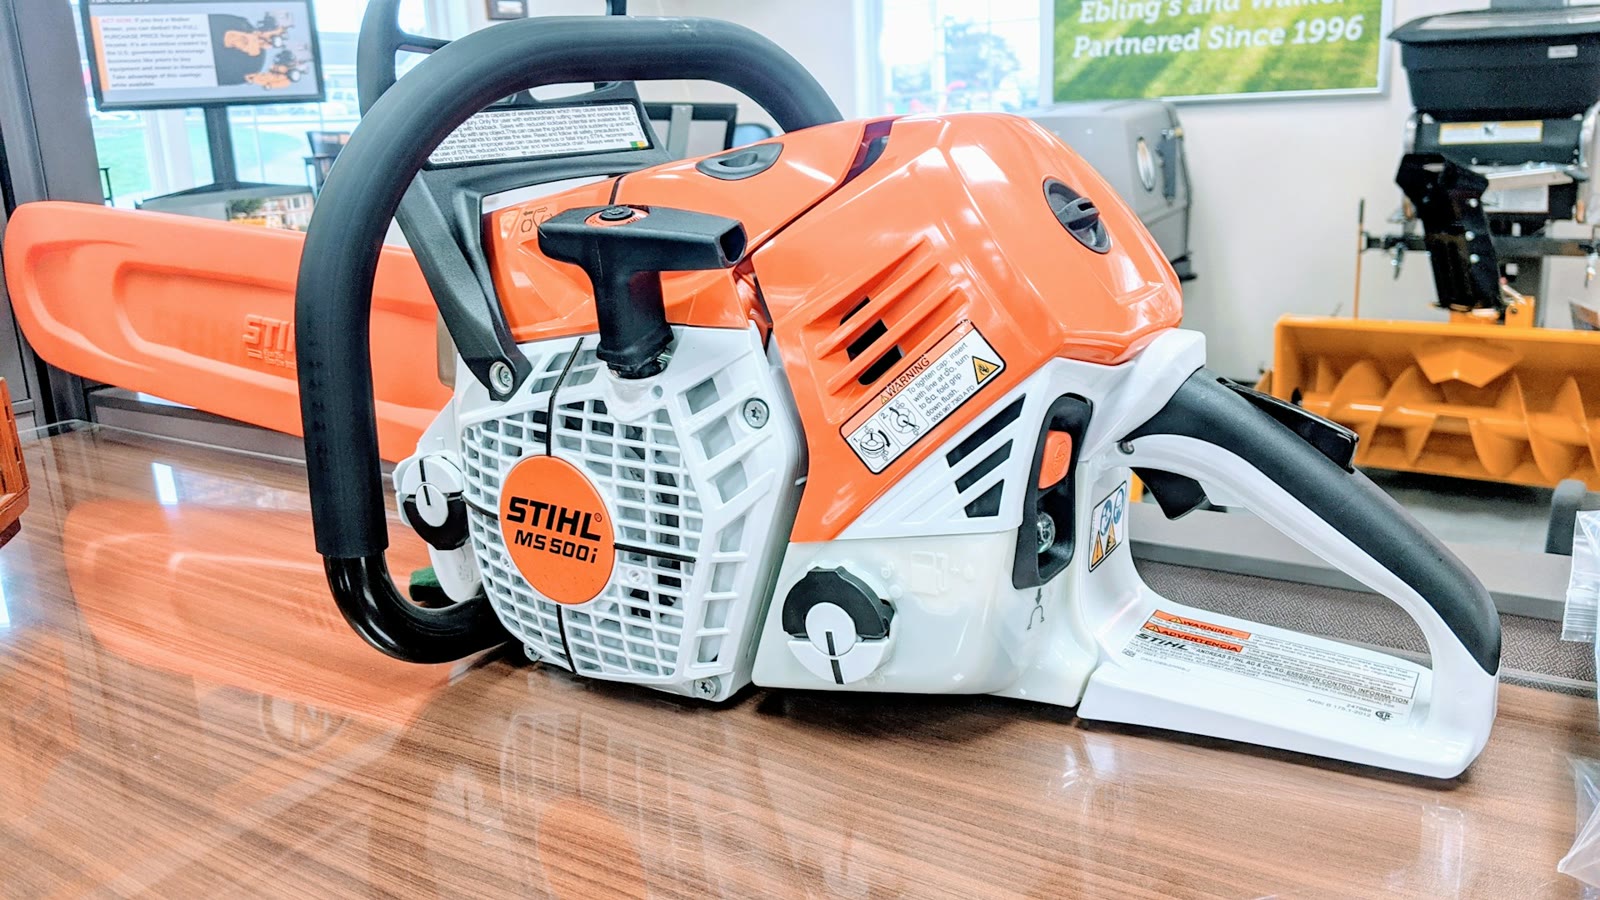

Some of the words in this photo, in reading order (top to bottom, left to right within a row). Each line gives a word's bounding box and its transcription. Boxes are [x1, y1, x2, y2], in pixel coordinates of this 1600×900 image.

[1073, 27, 1200, 58] Partnered
[1208, 24, 1285, 49] Since
[1291, 16, 1364, 44] 1996
[886, 357, 930, 396] WARNING
[912, 389, 926, 402] with
[925, 380, 937, 391] line
[956, 354, 969, 365] turn
[915, 369, 937, 389] tighten
[949, 343, 967, 359] insert
[936, 382, 950, 394] fold
[948, 372, 963, 385] grip
[925, 400, 942, 416] down
[506, 496, 602, 542] STIHL
[514, 530, 546, 550] MS
[549, 538, 598, 564] 500i
[1160, 630, 1239, 652] ADVERTENCIA
[1182, 620, 1234, 636] WARNING
[1135, 633, 1188, 651] STIHL
[1196, 649, 1227, 658] ANDREAS
[1286, 670, 1321, 683] EMISSION
[1322, 678, 1356, 692] CONTROL
[1358, 688, 1409, 704] INFORMATION
